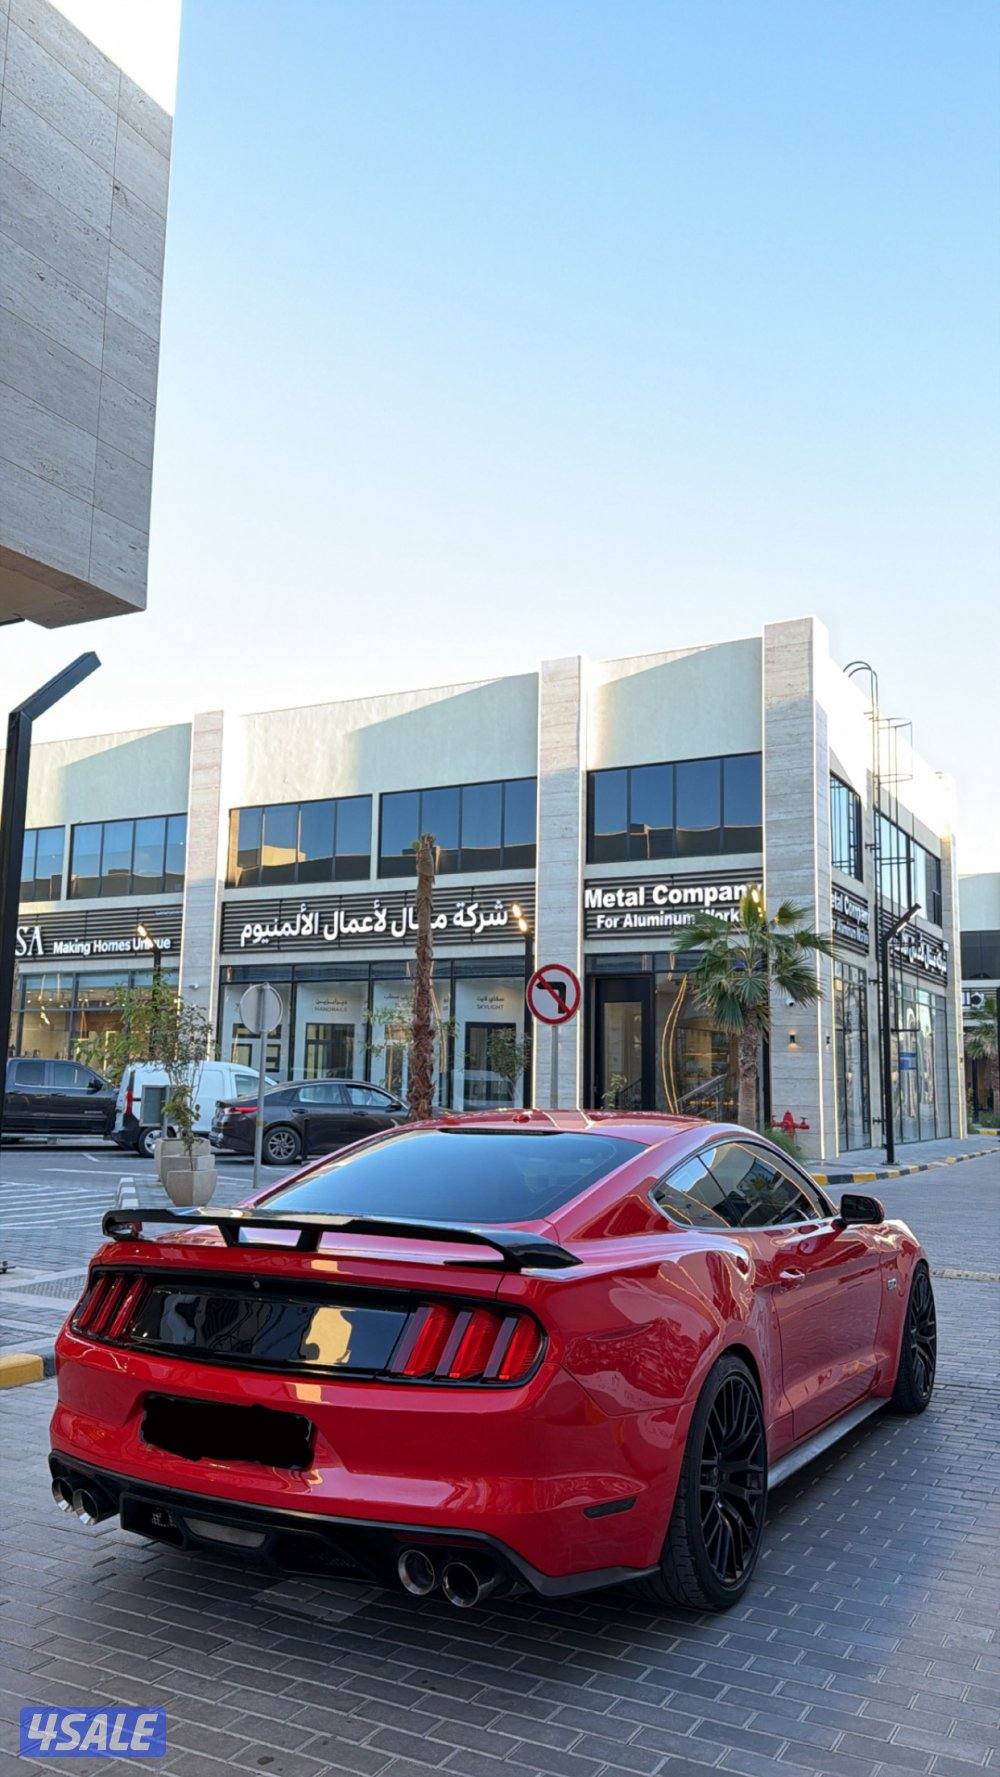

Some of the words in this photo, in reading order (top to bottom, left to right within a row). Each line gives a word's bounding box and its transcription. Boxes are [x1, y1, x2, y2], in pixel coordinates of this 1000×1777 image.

[584, 887, 645, 908] Metal
[240, 903, 319, 948] الألمنيوم
[323, 899, 388, 941] لأعمال
[453, 900, 508, 934] شركة
[597, 914, 619, 929] For
[53, 938, 91, 955] Making
[93, 938, 131, 953] Homes
